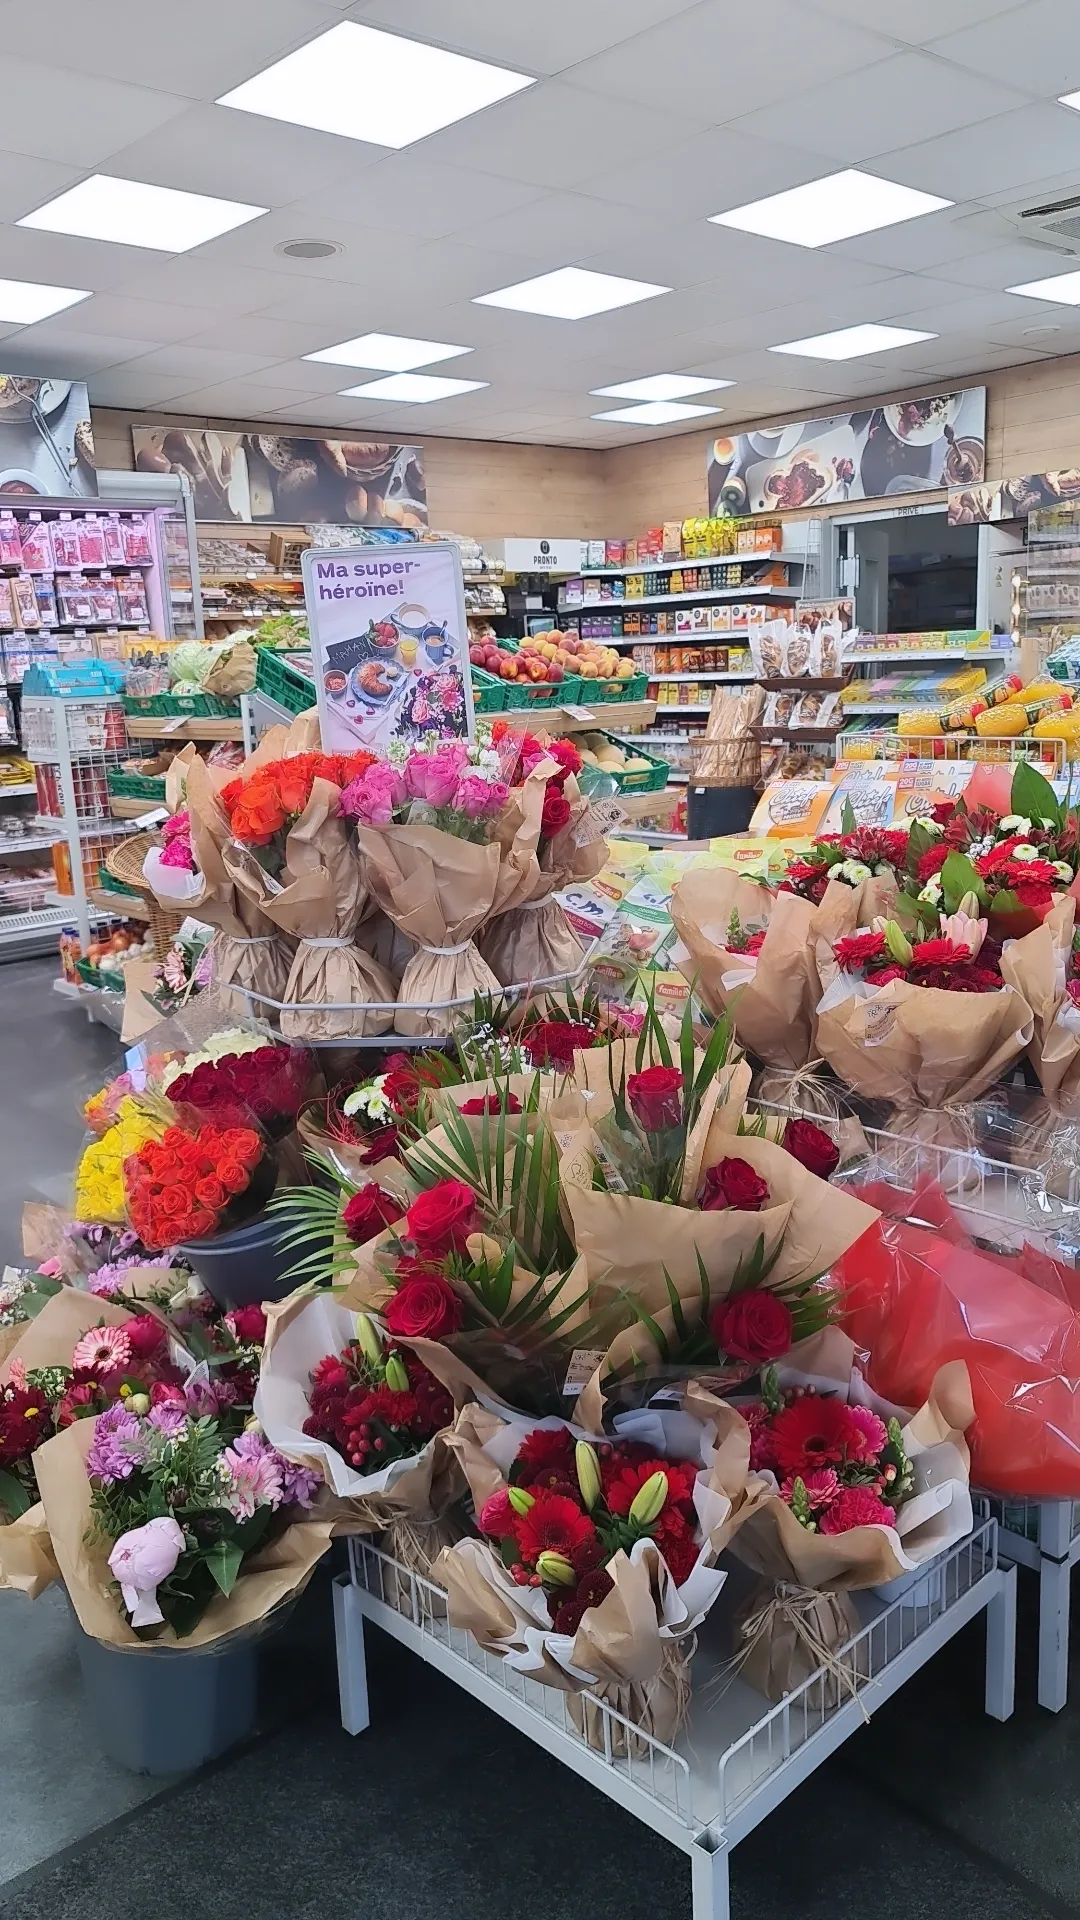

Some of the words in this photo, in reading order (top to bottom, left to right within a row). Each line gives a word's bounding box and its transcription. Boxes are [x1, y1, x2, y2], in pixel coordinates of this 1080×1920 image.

[533, 556, 558, 564] PRONTO
[317, 562, 348, 579] Ma
[353, 561, 420, 579] super-
[319, 580, 405, 600] héroïne!
[332, 639, 367, 665] MAMAN
[593, 880, 615, 897] familia
[658, 984, 682, 995] familia
